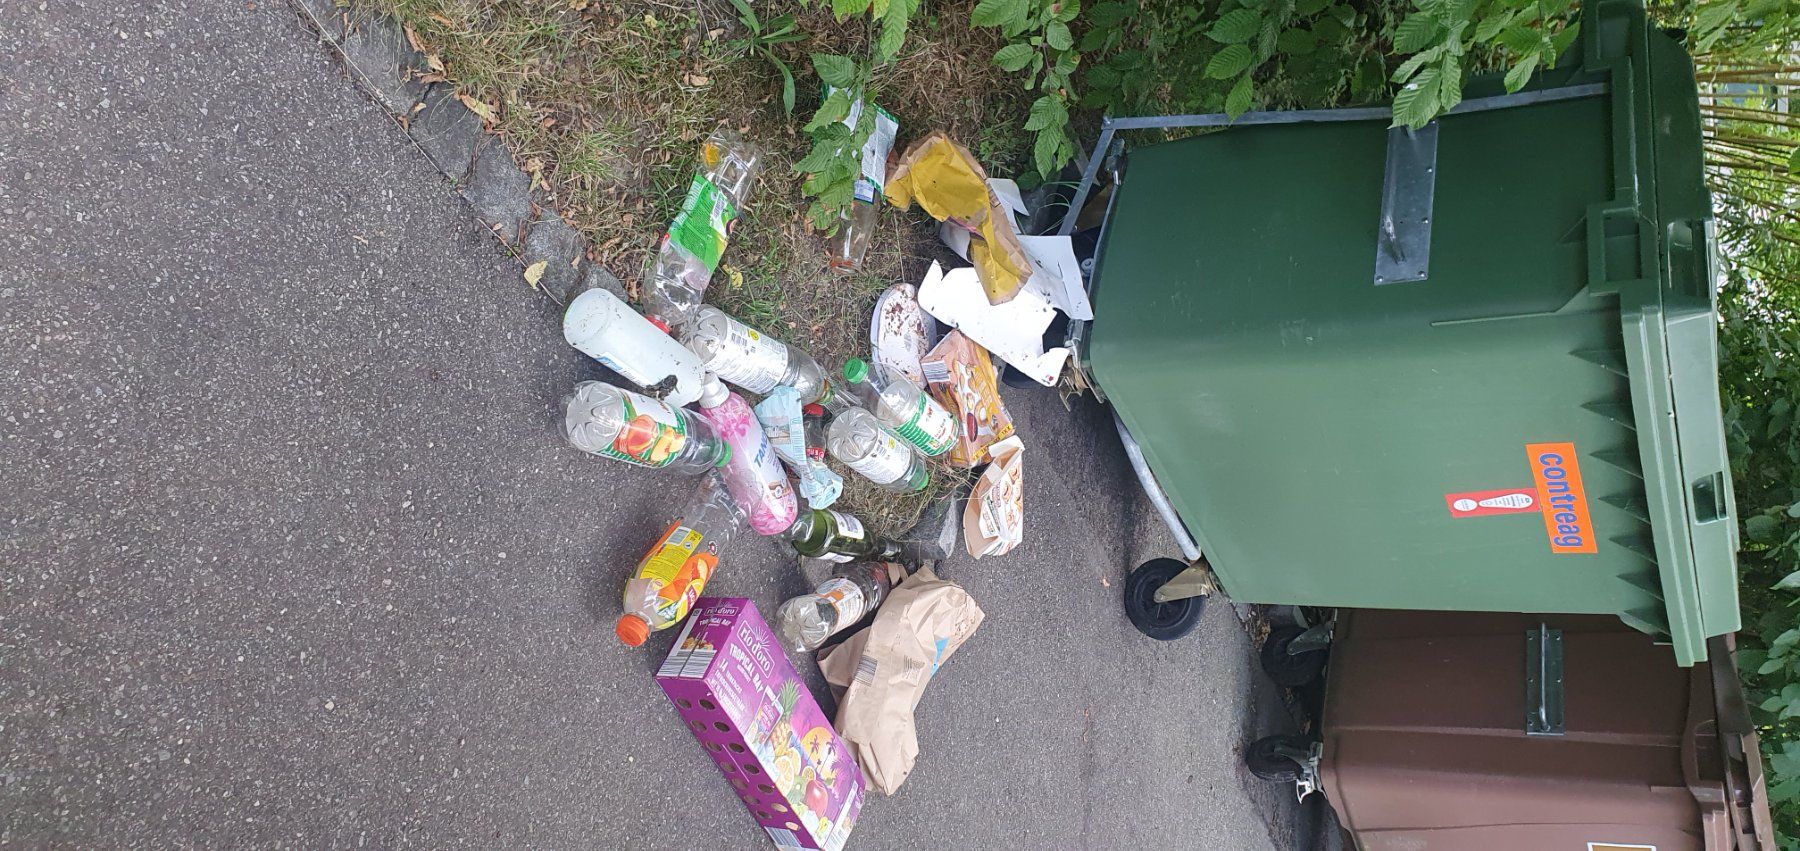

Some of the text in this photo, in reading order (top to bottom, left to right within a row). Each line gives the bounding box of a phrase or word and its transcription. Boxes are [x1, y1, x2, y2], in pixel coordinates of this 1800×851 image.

[1539, 453, 1583, 547] contreag
[719, 658, 729, 673] 14
[729, 643, 756, 677] TROPICAL
[752, 673, 764, 693] BAY
[740, 627, 753, 647] rio
[751, 642, 771, 671] d'oro
